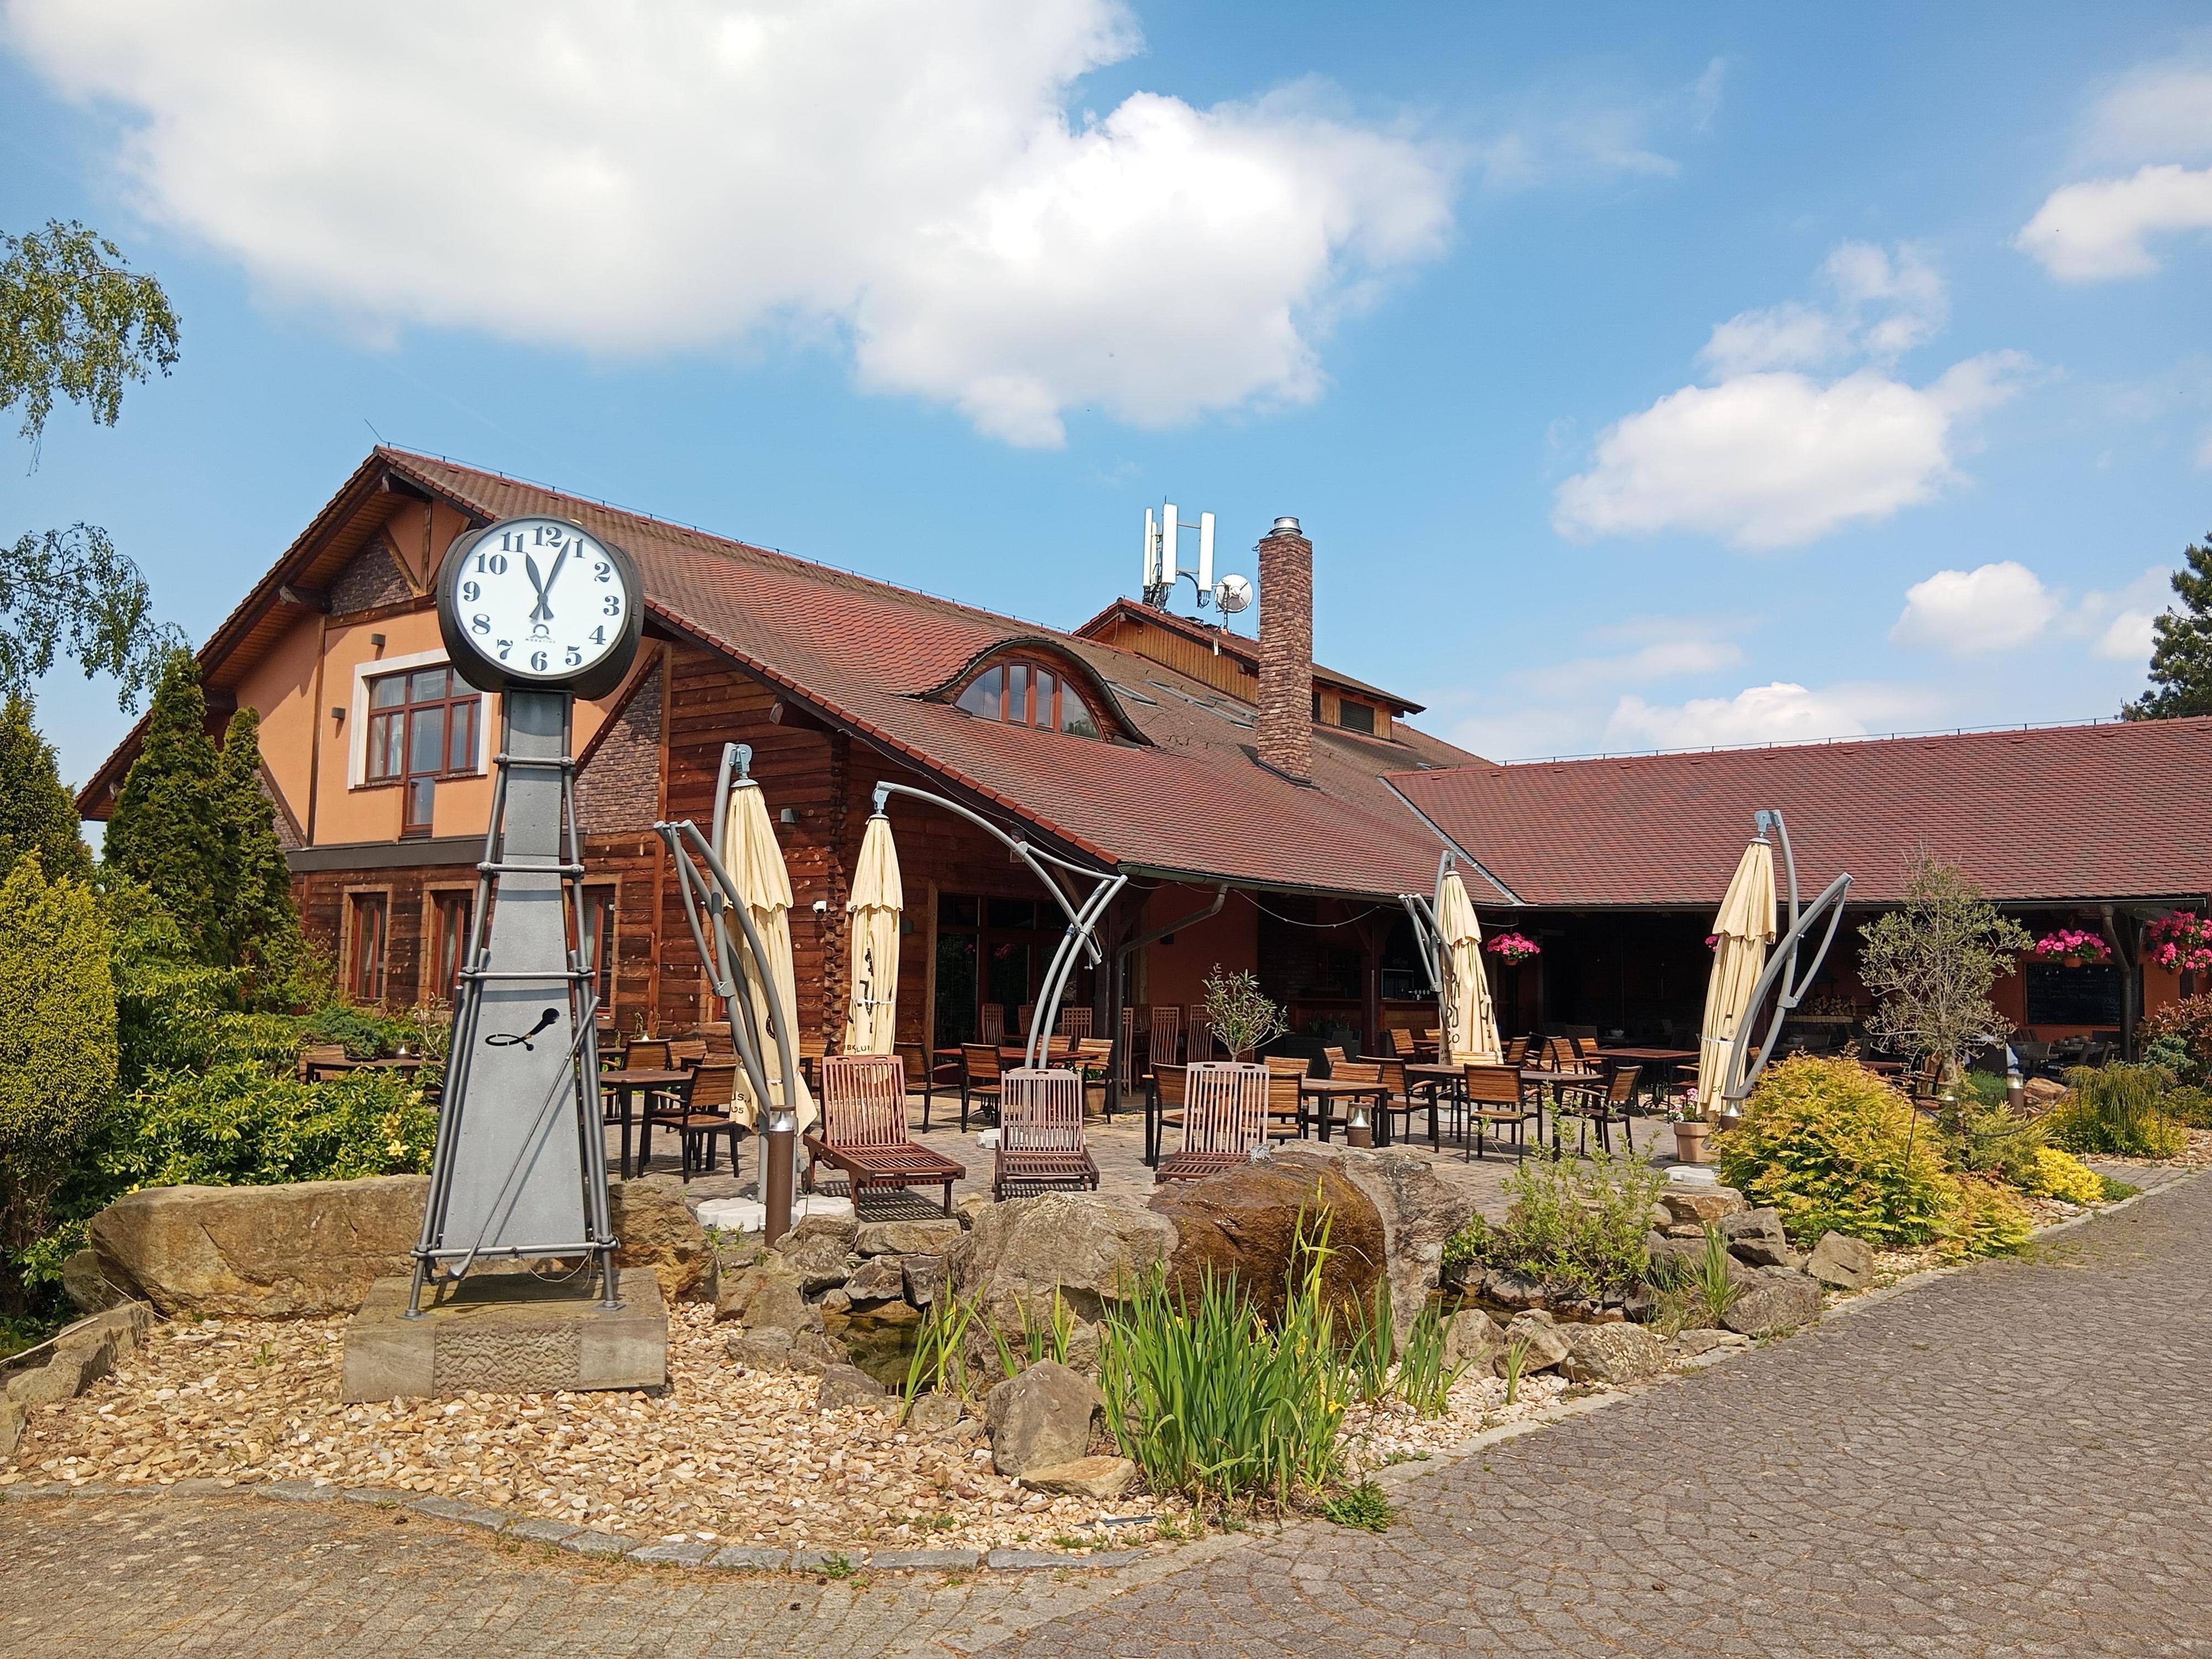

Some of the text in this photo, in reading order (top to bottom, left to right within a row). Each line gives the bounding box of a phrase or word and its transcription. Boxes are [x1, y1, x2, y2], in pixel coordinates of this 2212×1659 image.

[500, 531, 526, 553] 11
[533, 526, 562, 547] 12
[573, 539, 586, 559] 1
[475, 553, 508, 575] 10
[594, 562, 611, 582] 2
[463, 581, 481, 602] 9
[603, 596, 620, 616] 3
[472, 614, 491, 634] 8
[588, 625, 607, 645] 4
[497, 639, 513, 660] 7
[565, 645, 582, 666] 5
[531, 651, 547, 671] 6
